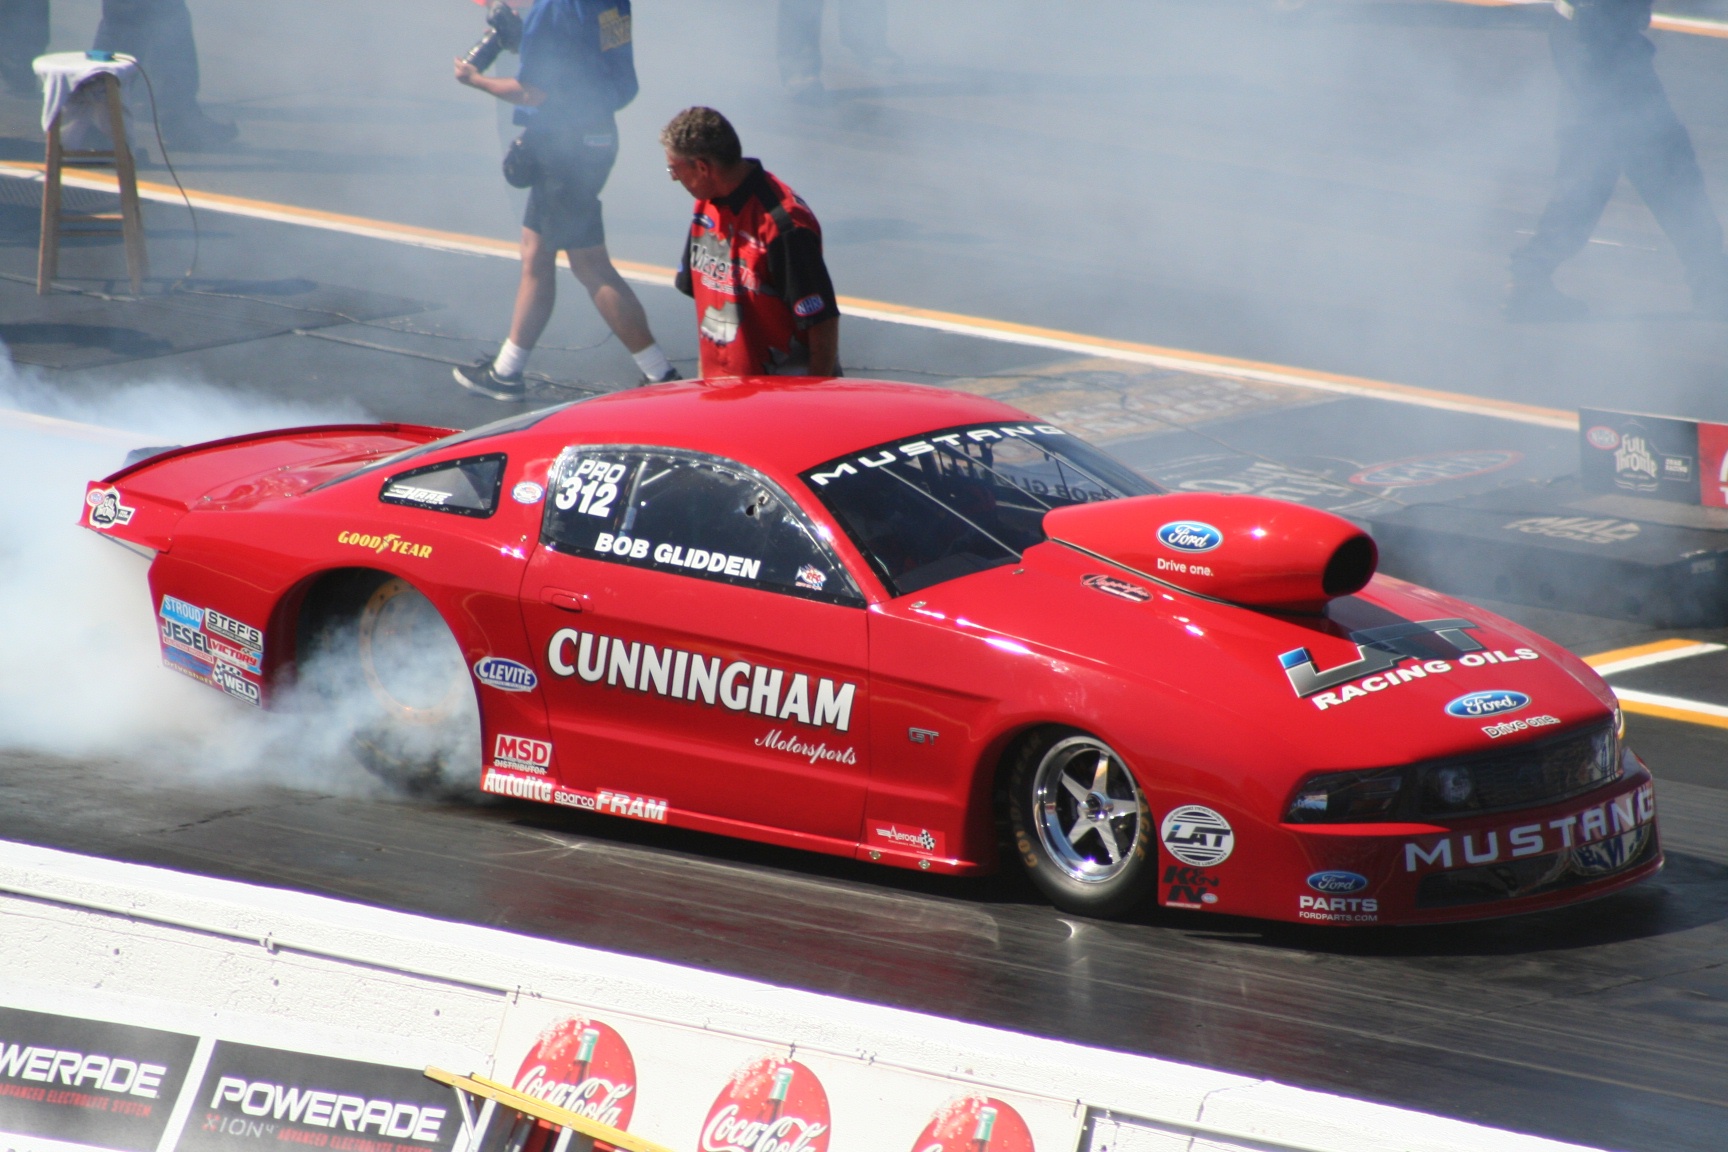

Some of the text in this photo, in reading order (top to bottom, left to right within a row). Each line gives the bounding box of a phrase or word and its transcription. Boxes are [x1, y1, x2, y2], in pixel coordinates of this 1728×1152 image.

[810, 425, 1066, 486] MUSTANG
[576, 459, 626, 484] PRO
[555, 477, 618, 517] 312
[1168, 525, 1211, 547] Ford
[594, 532, 761, 579] BOB GLIDDEN
[1157, 558, 1214, 577] Drive one.
[164, 597, 201, 623] STROUD
[163, 620, 212, 655] JESEL
[208, 611, 259, 643] STEF'S
[212, 640, 257, 666] VICTORY
[479, 656, 532, 686] CLEVITE
[547, 627, 857, 732] CUNNINGHAM
[1311, 648, 1540, 710] RACING OILS
[223, 673, 259, 699] WELD
[1463, 692, 1518, 715] Ford
[1482, 720, 1528, 738] Drive
[498, 737, 548, 764] MSD
[754, 728, 857, 766] Motorsports
[484, 768, 552, 803] Autolite
[554, 790, 595, 809] sparco
[595, 790, 667, 822] FRAM
[1165, 825, 1232, 848] LAT
[1404, 787, 1654, 872] MUSTANG
[1318, 874, 1356, 890] Ford
[1299, 895, 1378, 912] PARTS
[1299, 911, 1378, 921] FORDPARTS.COM
[210, 1077, 447, 1143] POWERADE
